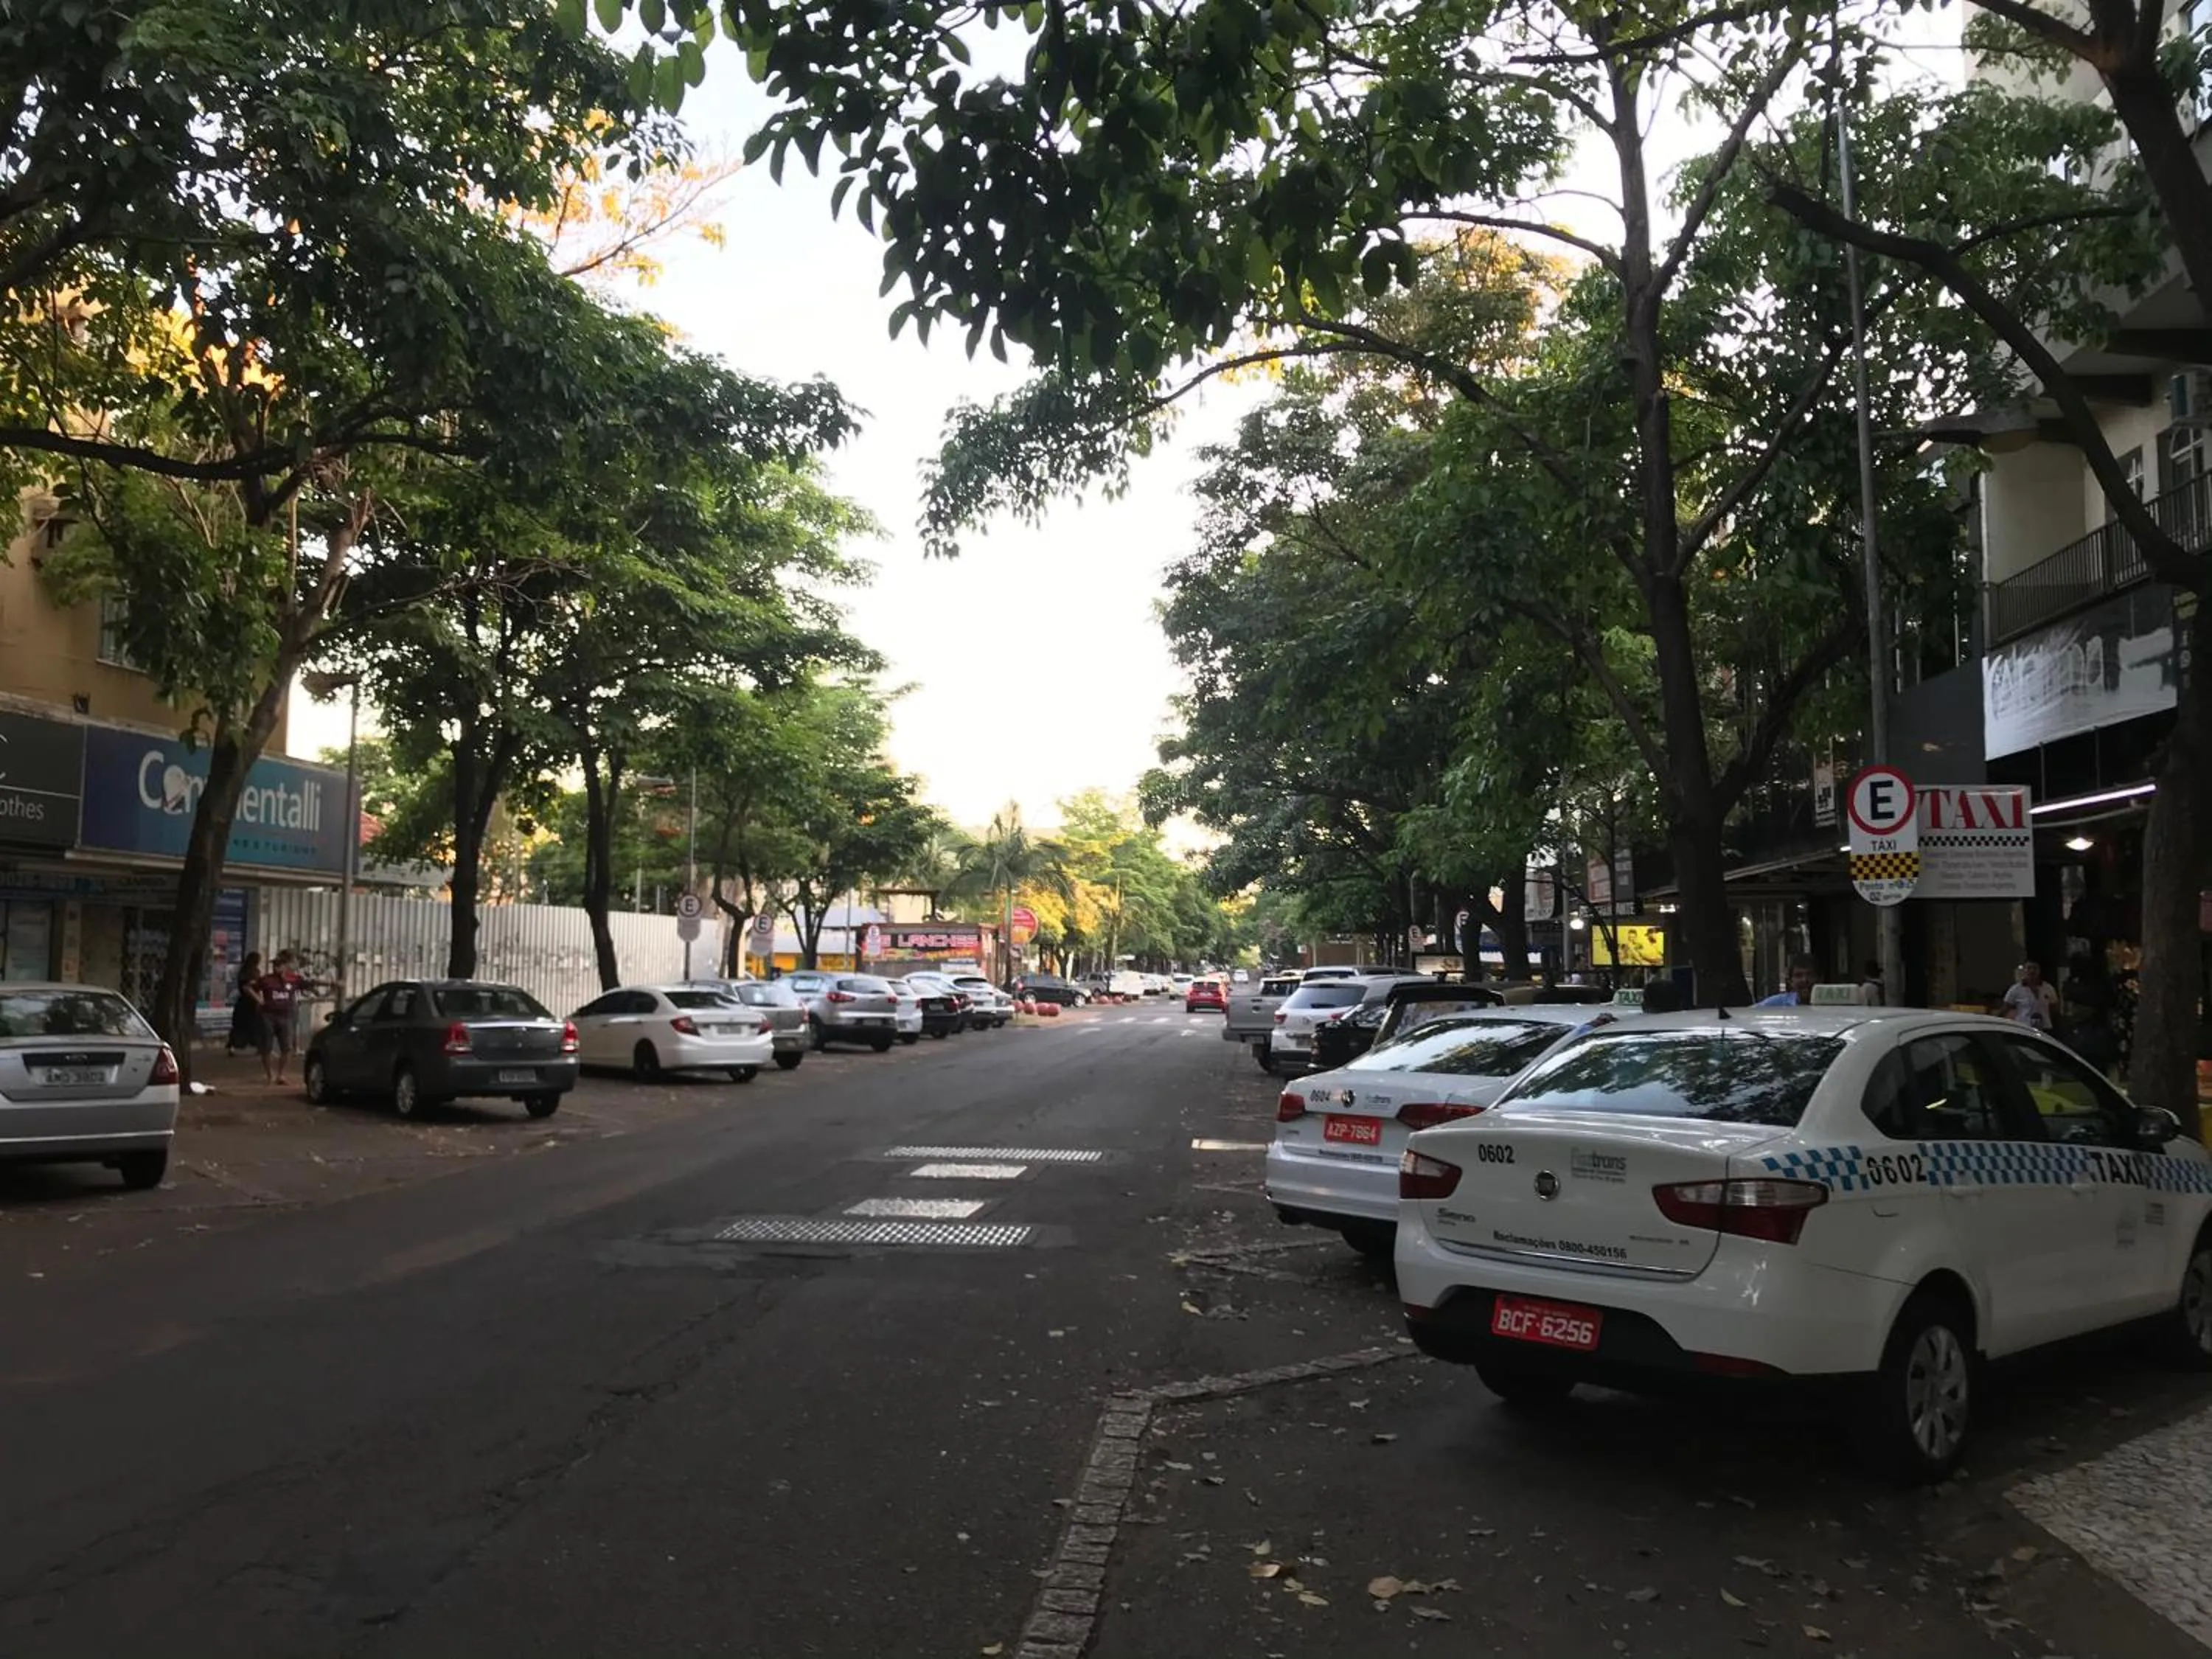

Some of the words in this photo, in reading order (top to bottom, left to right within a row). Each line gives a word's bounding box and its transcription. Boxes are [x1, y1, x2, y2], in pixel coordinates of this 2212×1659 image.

[1869, 780, 1895, 821] E
[1916, 789, 2028, 830] TAXI
[684, 898, 694, 912] E
[759, 917, 768, 929] E
[1478, 1144, 1515, 1164] 0602
[1866, 1154, 1927, 1185] 0602
[2088, 1152, 2144, 1185] TAXI
